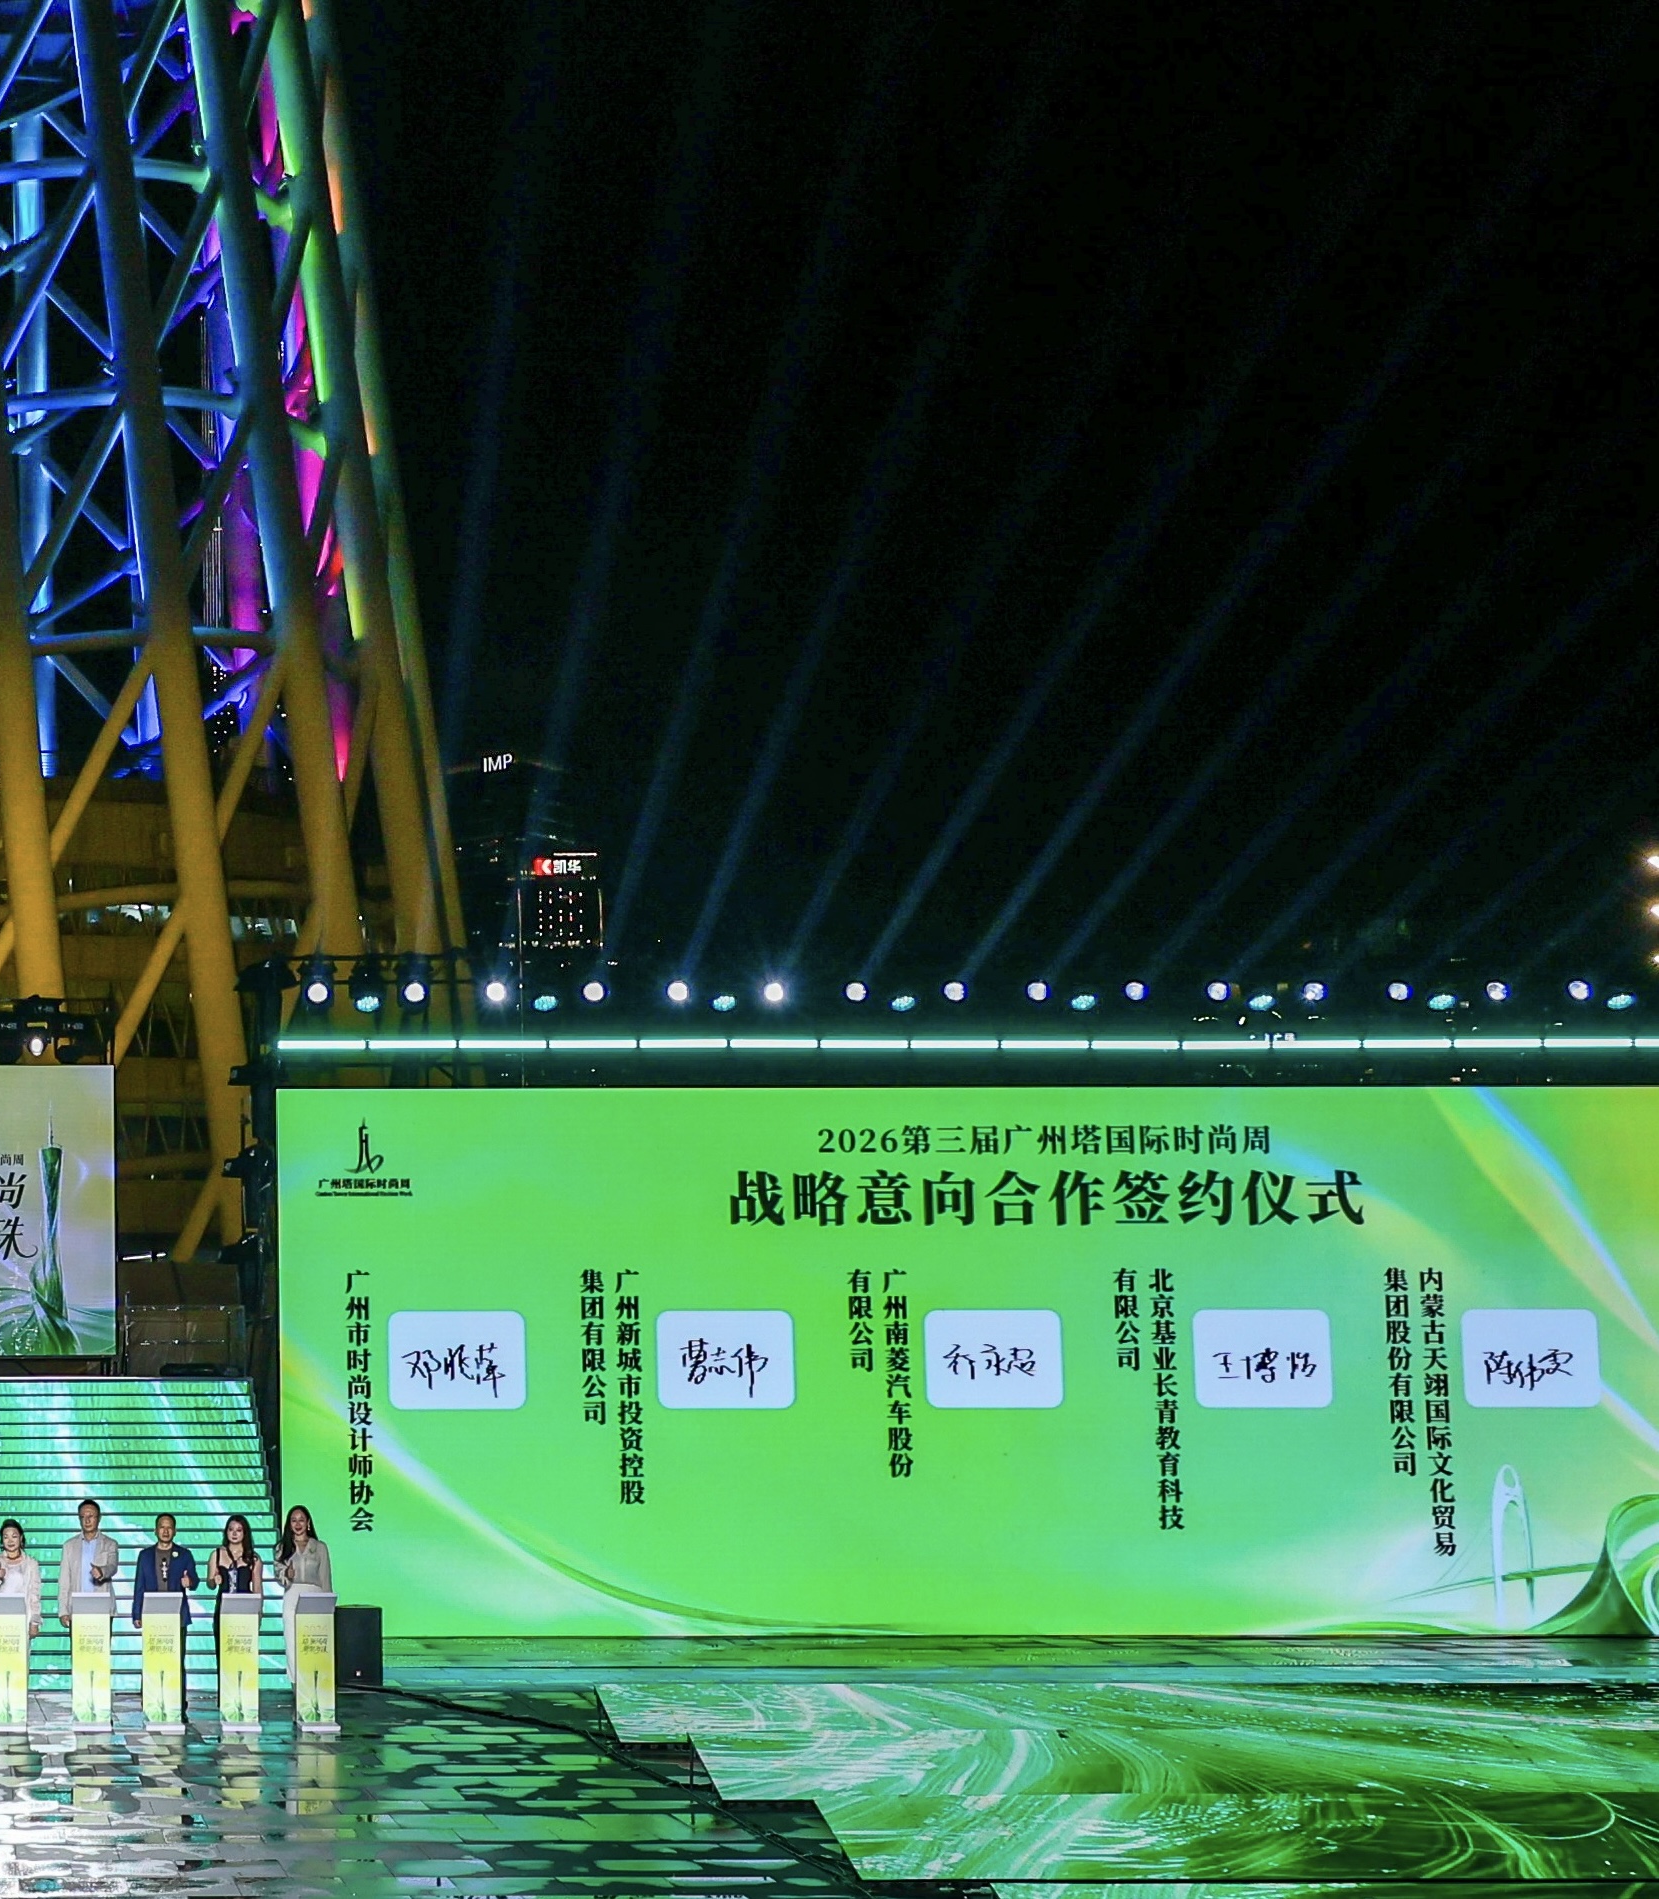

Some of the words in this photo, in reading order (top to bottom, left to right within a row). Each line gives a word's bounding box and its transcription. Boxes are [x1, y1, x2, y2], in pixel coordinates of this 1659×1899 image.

[483, 753, 513, 773] IMP
[553, 859, 582, 874] 凯华
[730, 1169, 1365, 1227] 战略意向合作签约仪式
[818, 1123, 1270, 1155] 2026第三届广州塔国际时尚周
[580, 1268, 607, 1426] 集团有限公司
[615, 1268, 645, 1505] 广州新城市投资控股
[847, 1268, 874, 1373] 有限公司
[883, 1268, 914, 1478] 广州南菱汽车股份
[1113, 1267, 1141, 1372] 有限公司
[1384, 1267, 1417, 1477] 集团股份有限公司
[345, 1269, 375, 1532] 广州市时尚设计师协会
[1148, 1268, 1185, 1530] 北京基业长青教育科技
[1419, 1267, 1457, 1557] 内蒙古天翊国际文化贸易
